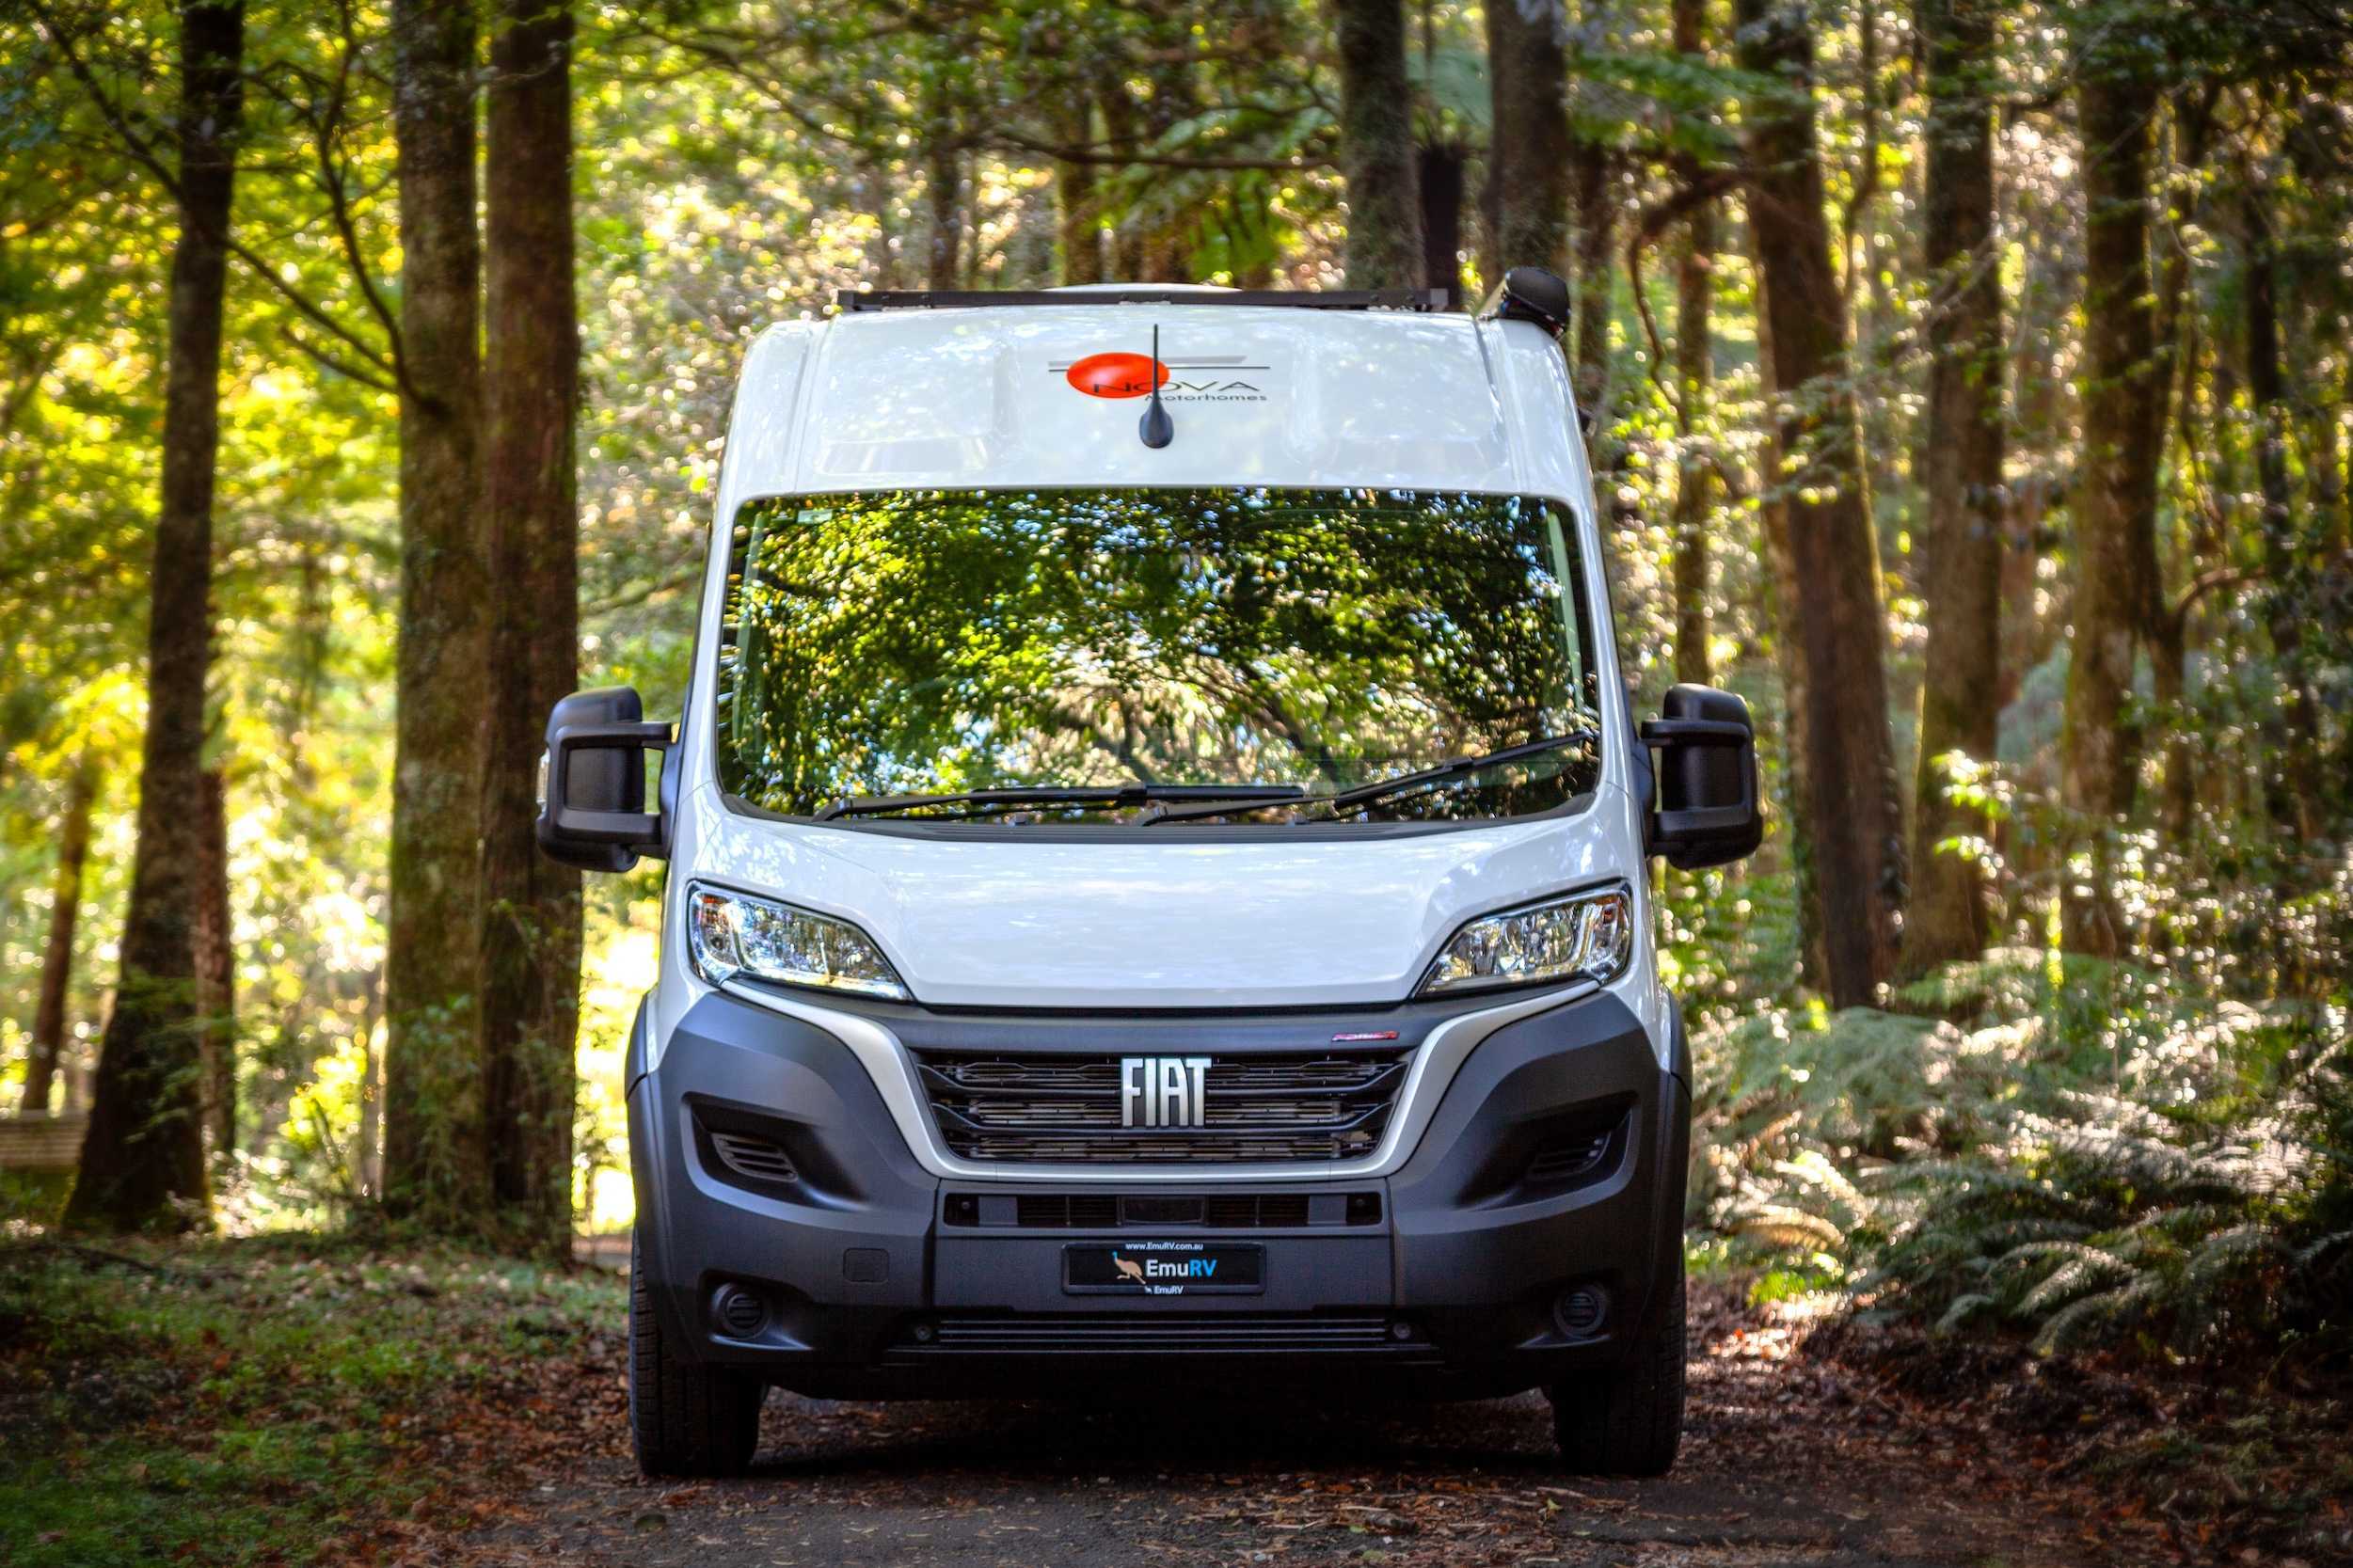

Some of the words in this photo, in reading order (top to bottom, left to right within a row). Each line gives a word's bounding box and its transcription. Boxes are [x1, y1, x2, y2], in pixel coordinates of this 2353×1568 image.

[1093, 381, 1261, 393] NOVA
[1121, 1057, 1213, 1127] FIAT
[1125, 1242, 1203, 1250] www.EmuRV.com.au
[1146, 1259, 1217, 1277] EmuRV
[1153, 1286, 1184, 1294] EmuRV
